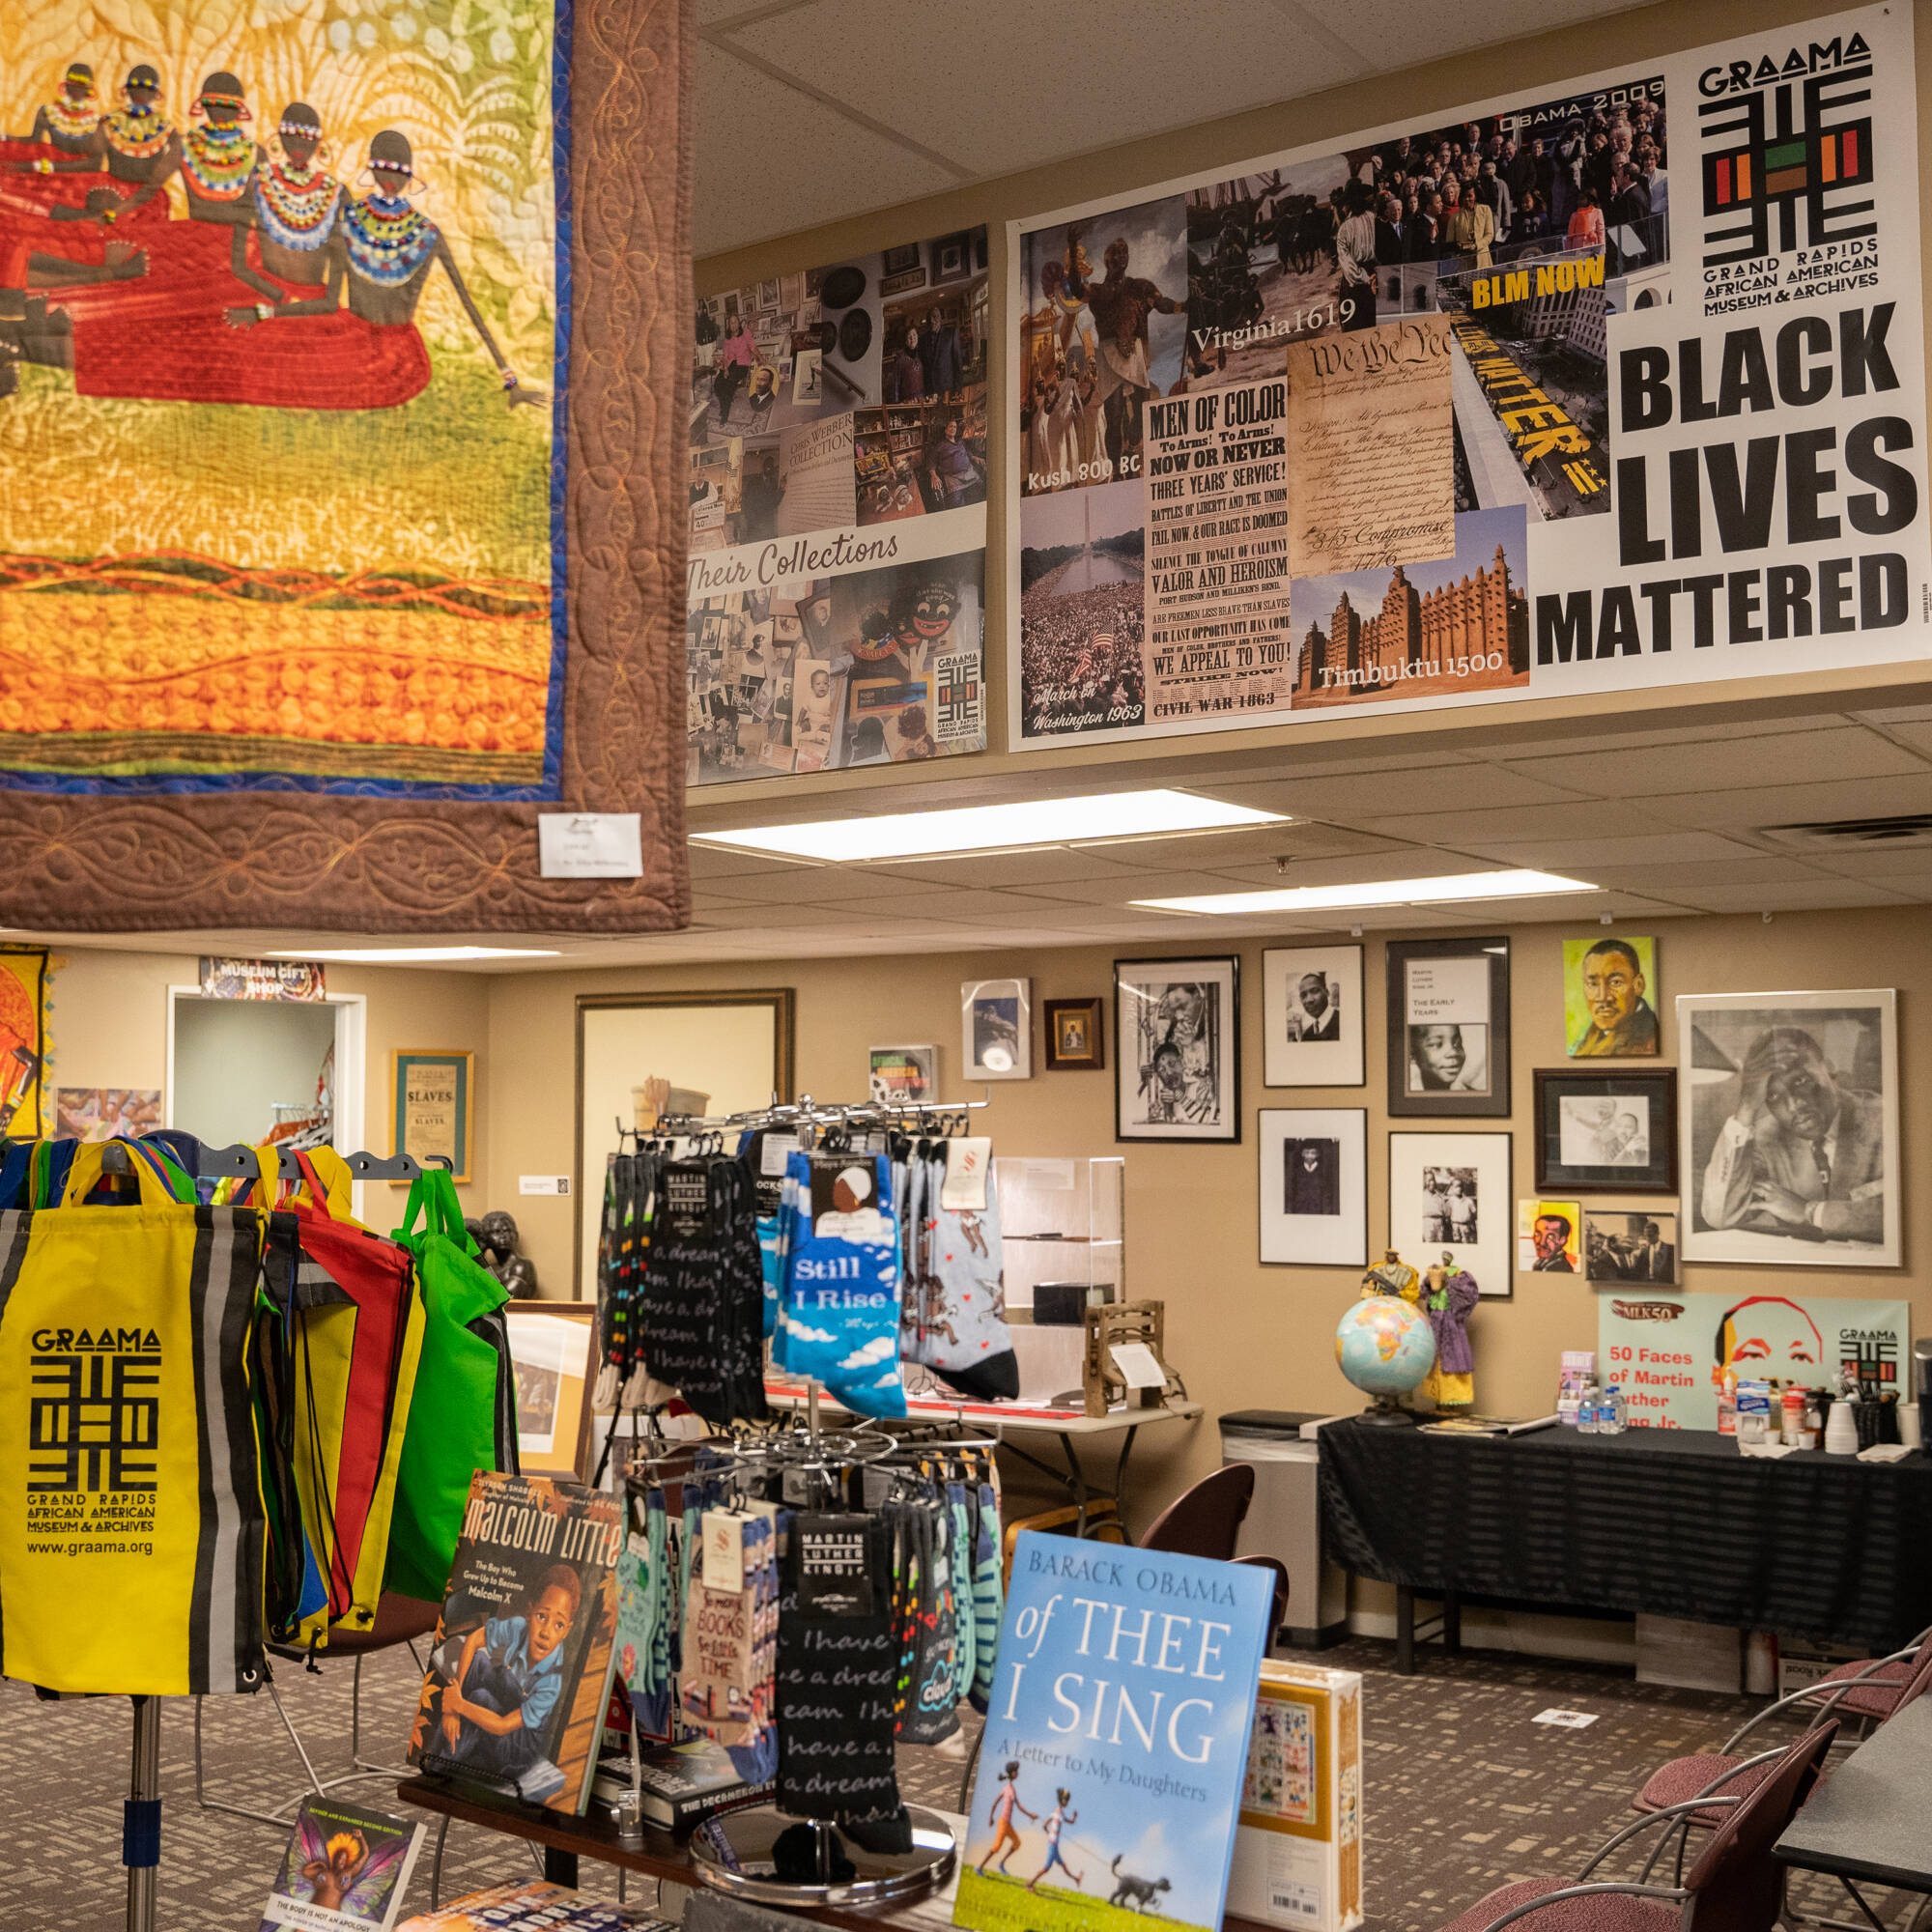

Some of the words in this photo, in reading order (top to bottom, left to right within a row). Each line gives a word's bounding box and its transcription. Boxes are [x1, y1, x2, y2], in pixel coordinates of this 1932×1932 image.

[1698, 32, 1871, 98] GRAAMA
[1499, 103, 1581, 132] OBAMA
[1594, 80, 1664, 110] 2009
[1704, 258, 1779, 283] GRAND
[1797, 238, 1878, 267] RAPIDS
[1472, 270, 1529, 310] BLM
[1537, 255, 1605, 297] NOW
[1704, 273, 1778, 299] AFRICAN
[1786, 253, 1878, 284] AMERICAN
[1704, 292, 1772, 317] MUSEUM
[1775, 289, 1791, 304] &
[1793, 271, 1878, 300] ARCHIVES
[1620, 301, 1900, 433] BLACK
[1150, 400, 1190, 441] MEN
[1195, 394, 1219, 433] OF
[1224, 383, 1286, 427] COLOR
[811, 412, 853, 442] WEBBER
[1160, 441, 1176, 453] To
[1178, 435, 1212, 450] Arms!
[1218, 432, 1236, 443] To
[1237, 423, 1275, 440] Arms!
[789, 429, 853, 467] COLLECTION
[1150, 452, 1191, 476] NOW
[1194, 448, 1218, 469] OR
[1223, 437, 1286, 465] NEVER
[1028, 469, 1071, 491] Kush
[1078, 458, 1114, 482] 800
[1121, 454, 1141, 474] BC
[1151, 478, 1185, 500] THREE
[1233, 462, 1286, 488] SERVICE!
[1151, 504, 1183, 522] BATTLES
[1185, 502, 1194, 517] OF
[1196, 497, 1227, 515] LIBERTY
[1228, 496, 1243, 510] AND
[1245, 492, 1262, 505] THE
[1264, 487, 1288, 503] UNION
[1617, 415, 1919, 566] LIVES
[1151, 529, 1170, 547] FAIL
[1193, 526, 1200, 540] &
[1201, 523, 1217, 539] OUR
[1219, 519, 1241, 536] RACE
[1242, 517, 1251, 532] IS
[1252, 511, 1288, 530] DOOMED
[1354, 523, 1449, 545] Compromise
[688, 557, 752, 591] Their
[757, 534, 898, 585] Collections
[1151, 555, 1182, 571] SILENCE
[1186, 552, 1202, 566] THE
[1207, 547, 1236, 563] TONGUE
[1238, 544, 1248, 557] OF
[1251, 539, 1288, 555] CALUMNY
[1151, 570, 1194, 594] VALOR
[1198, 565, 1226, 587] AND
[1231, 556, 1289, 583] HEROISM
[1152, 614, 1167, 625] ARE
[1168, 610, 1200, 623] FREEMEN
[1202, 608, 1218, 618] LESS
[1218, 604, 1241, 616] BRAVE
[1242, 602, 1263, 612] THAN
[1264, 598, 1291, 611] SLAVES
[1159, 595, 1177, 606] PORT
[1179, 593, 1205, 603] HUDSON
[1206, 589, 1220, 599] AND
[1537, 551, 1910, 667] MATTERED
[1152, 631, 1168, 643] OUR
[1171, 628, 1191, 641] LAST
[1192, 620, 1247, 639] OPPORTUNITY
[1250, 618, 1266, 632] HAS
[1268, 615, 1291, 629] COME
[938, 653, 979, 668] GRAAMA
[1152, 656, 1174, 676] WE
[1179, 649, 1230, 672] APPEAL
[1236, 646, 1253, 667] TO
[1259, 642, 1291, 665] YOU!
[1236, 668, 1283, 677] NOW!
[1319, 657, 1440, 689] Timbuktu
[1446, 652, 1503, 678] 1500
[1034, 687, 1077, 704] March
[1081, 686, 1096, 698] on
[1153, 701, 1193, 717] CIVIL
[1199, 696, 1233, 711] WAR
[1238, 692, 1275, 708] 1863
[1033, 711, 1105, 732] Washington
[1106, 704, 1144, 723] 1963
[220, 965, 276, 979] MUSEUM
[278, 967, 306, 980] GIFT
[246, 980, 284, 995] SHOP
[408, 1091, 453, 1102] SLAVES
[795, 1256, 861, 1280] Still
[794, 1290, 806, 1310] I
[816, 1288, 887, 1310] Rise
[31, 1328, 162, 1352] GRAAMA
[1839, 1329, 1897, 1341] GRAAMA
[1609, 1346, 1633, 1361] 50
[1638, 1348, 1693, 1365] Faces
[1608, 1368, 1629, 1383] of
[1634, 1370, 1694, 1387] Martin
[1626, 1392, 1670, 1407] ther
[27, 1494, 86, 1505] GRAND
[99, 1493, 156, 1505] RAPIDS
[27, 1508, 84, 1519] AFRICAN
[90, 1507, 155, 1519] AMERICAN
[27, 1521, 78, 1533] MUSEUM
[80, 1522, 93, 1532] &
[95, 1520, 155, 1532] ARCHIVES
[802, 1533, 864, 1544] MARTIN
[27, 1543, 153, 1556] www.graama.org
[802, 1548, 864, 1559] LUTHER
[464, 1570, 479, 1580] Grew
[480, 1573, 490, 1584] Up
[490, 1577, 497, 1585] to
[498, 1577, 525, 1592] Become
[475, 1560, 488, 1571] The
[488, 1562, 500, 1576] Boy
[501, 1566, 517, 1577] Who
[1028, 1548, 1126, 1587] BARACK
[1135, 1568, 1237, 1607] OBAMA
[468, 1584, 503, 1603] Malcolm
[503, 1592, 512, 1605] X
[697, 1610, 745, 1638] BOOKS
[1014, 1593, 1063, 1659] of
[1071, 1596, 1232, 1683] THEE
[700, 1656, 734, 1679] TIME
[1002, 1661, 1027, 1721] I
[1046, 1671, 1215, 1765] SING
[997, 1738, 1010, 1755] A
[1013, 1740, 1061, 1767] Letter
[1065, 1756, 1082, 1772] to
[1085, 1758, 1117, 1785] My
[1119, 1765, 1208, 1803] Daughters
[680, 1800, 701, 1814] THE
[276, 1900, 289, 1911] THE
[290, 1904, 306, 1917] BODY
[307, 1909, 314, 1918] IS
[314, 1911, 328, 1922] NOT
[328, 1916, 339, 1924] AN
[339, 1918, 371, 1932] APOLOGY
